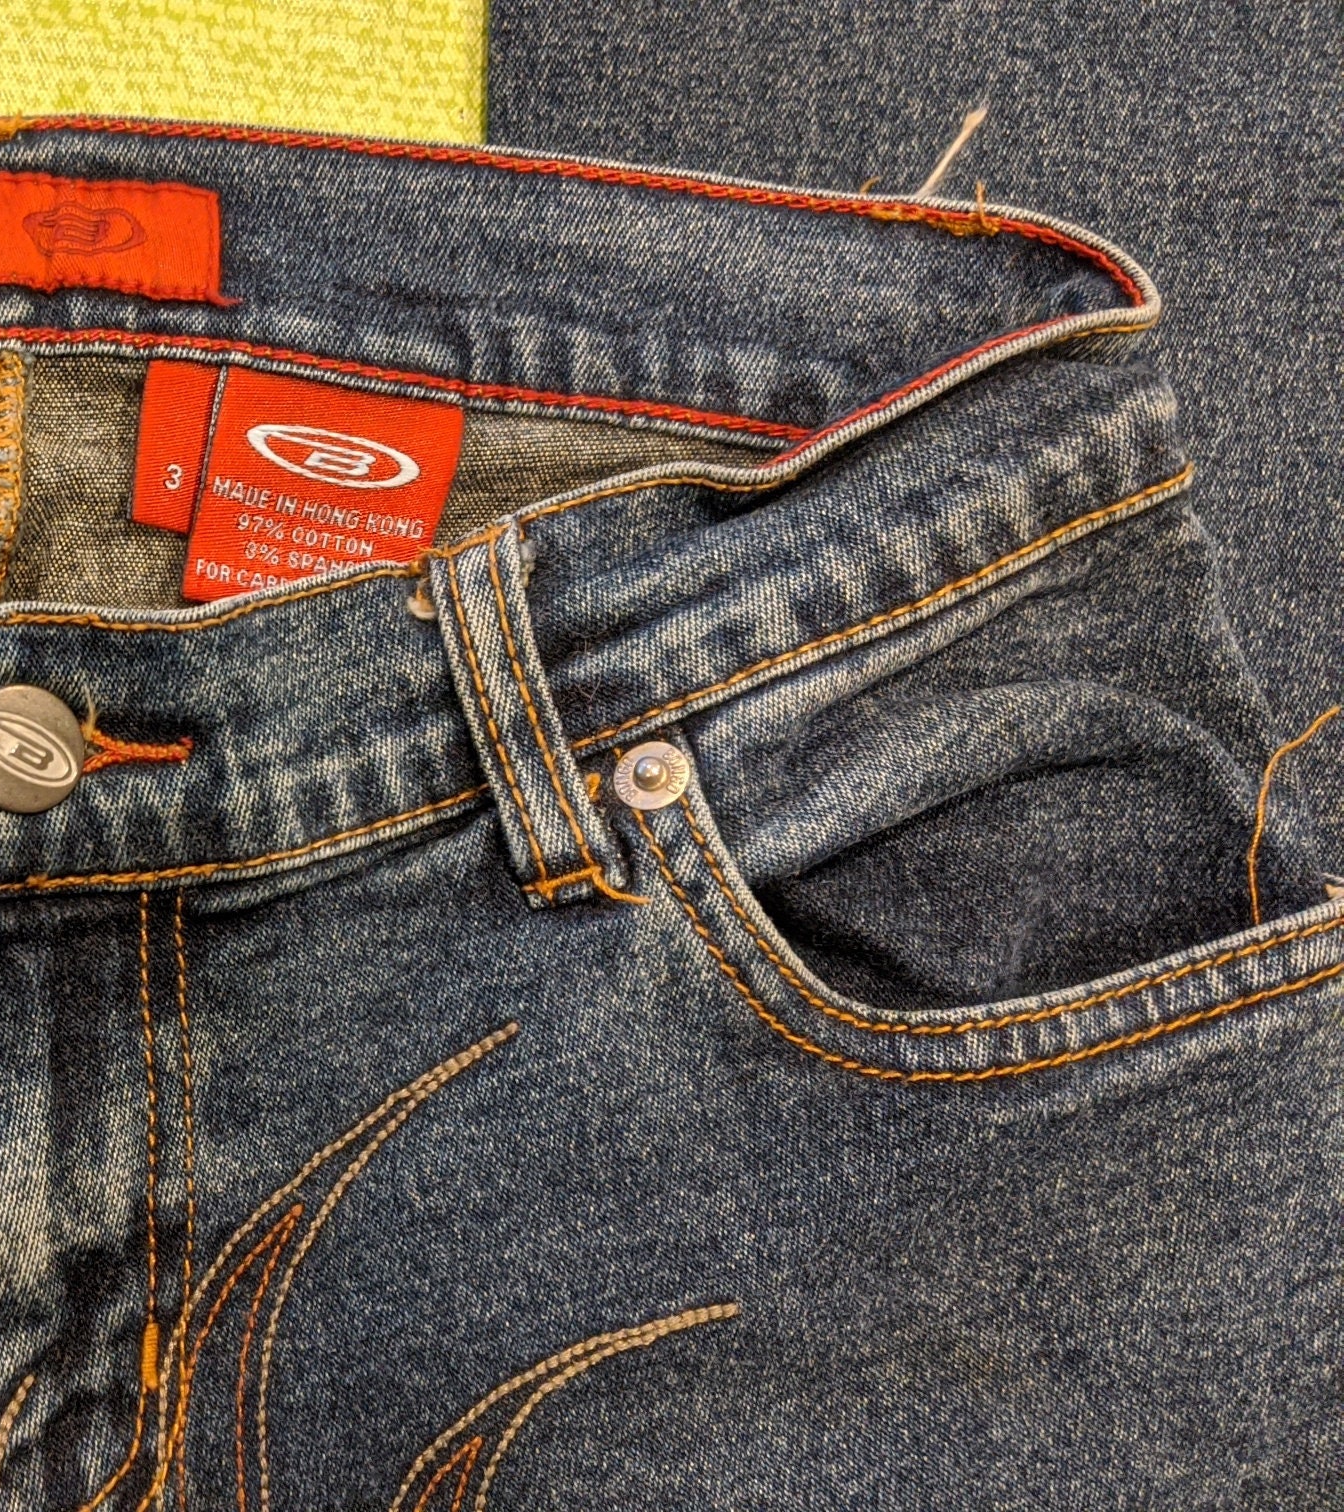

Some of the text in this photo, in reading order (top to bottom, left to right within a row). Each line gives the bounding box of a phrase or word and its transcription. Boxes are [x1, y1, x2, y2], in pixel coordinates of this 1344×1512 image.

[164, 464, 183, 491] 3
[212, 475, 425, 540] MADE IN HONG KONG
[237, 513, 375, 557] 97% COTTON
[195, 558, 232, 584] FOR
[244, 541, 361, 577] 3% SPAN
